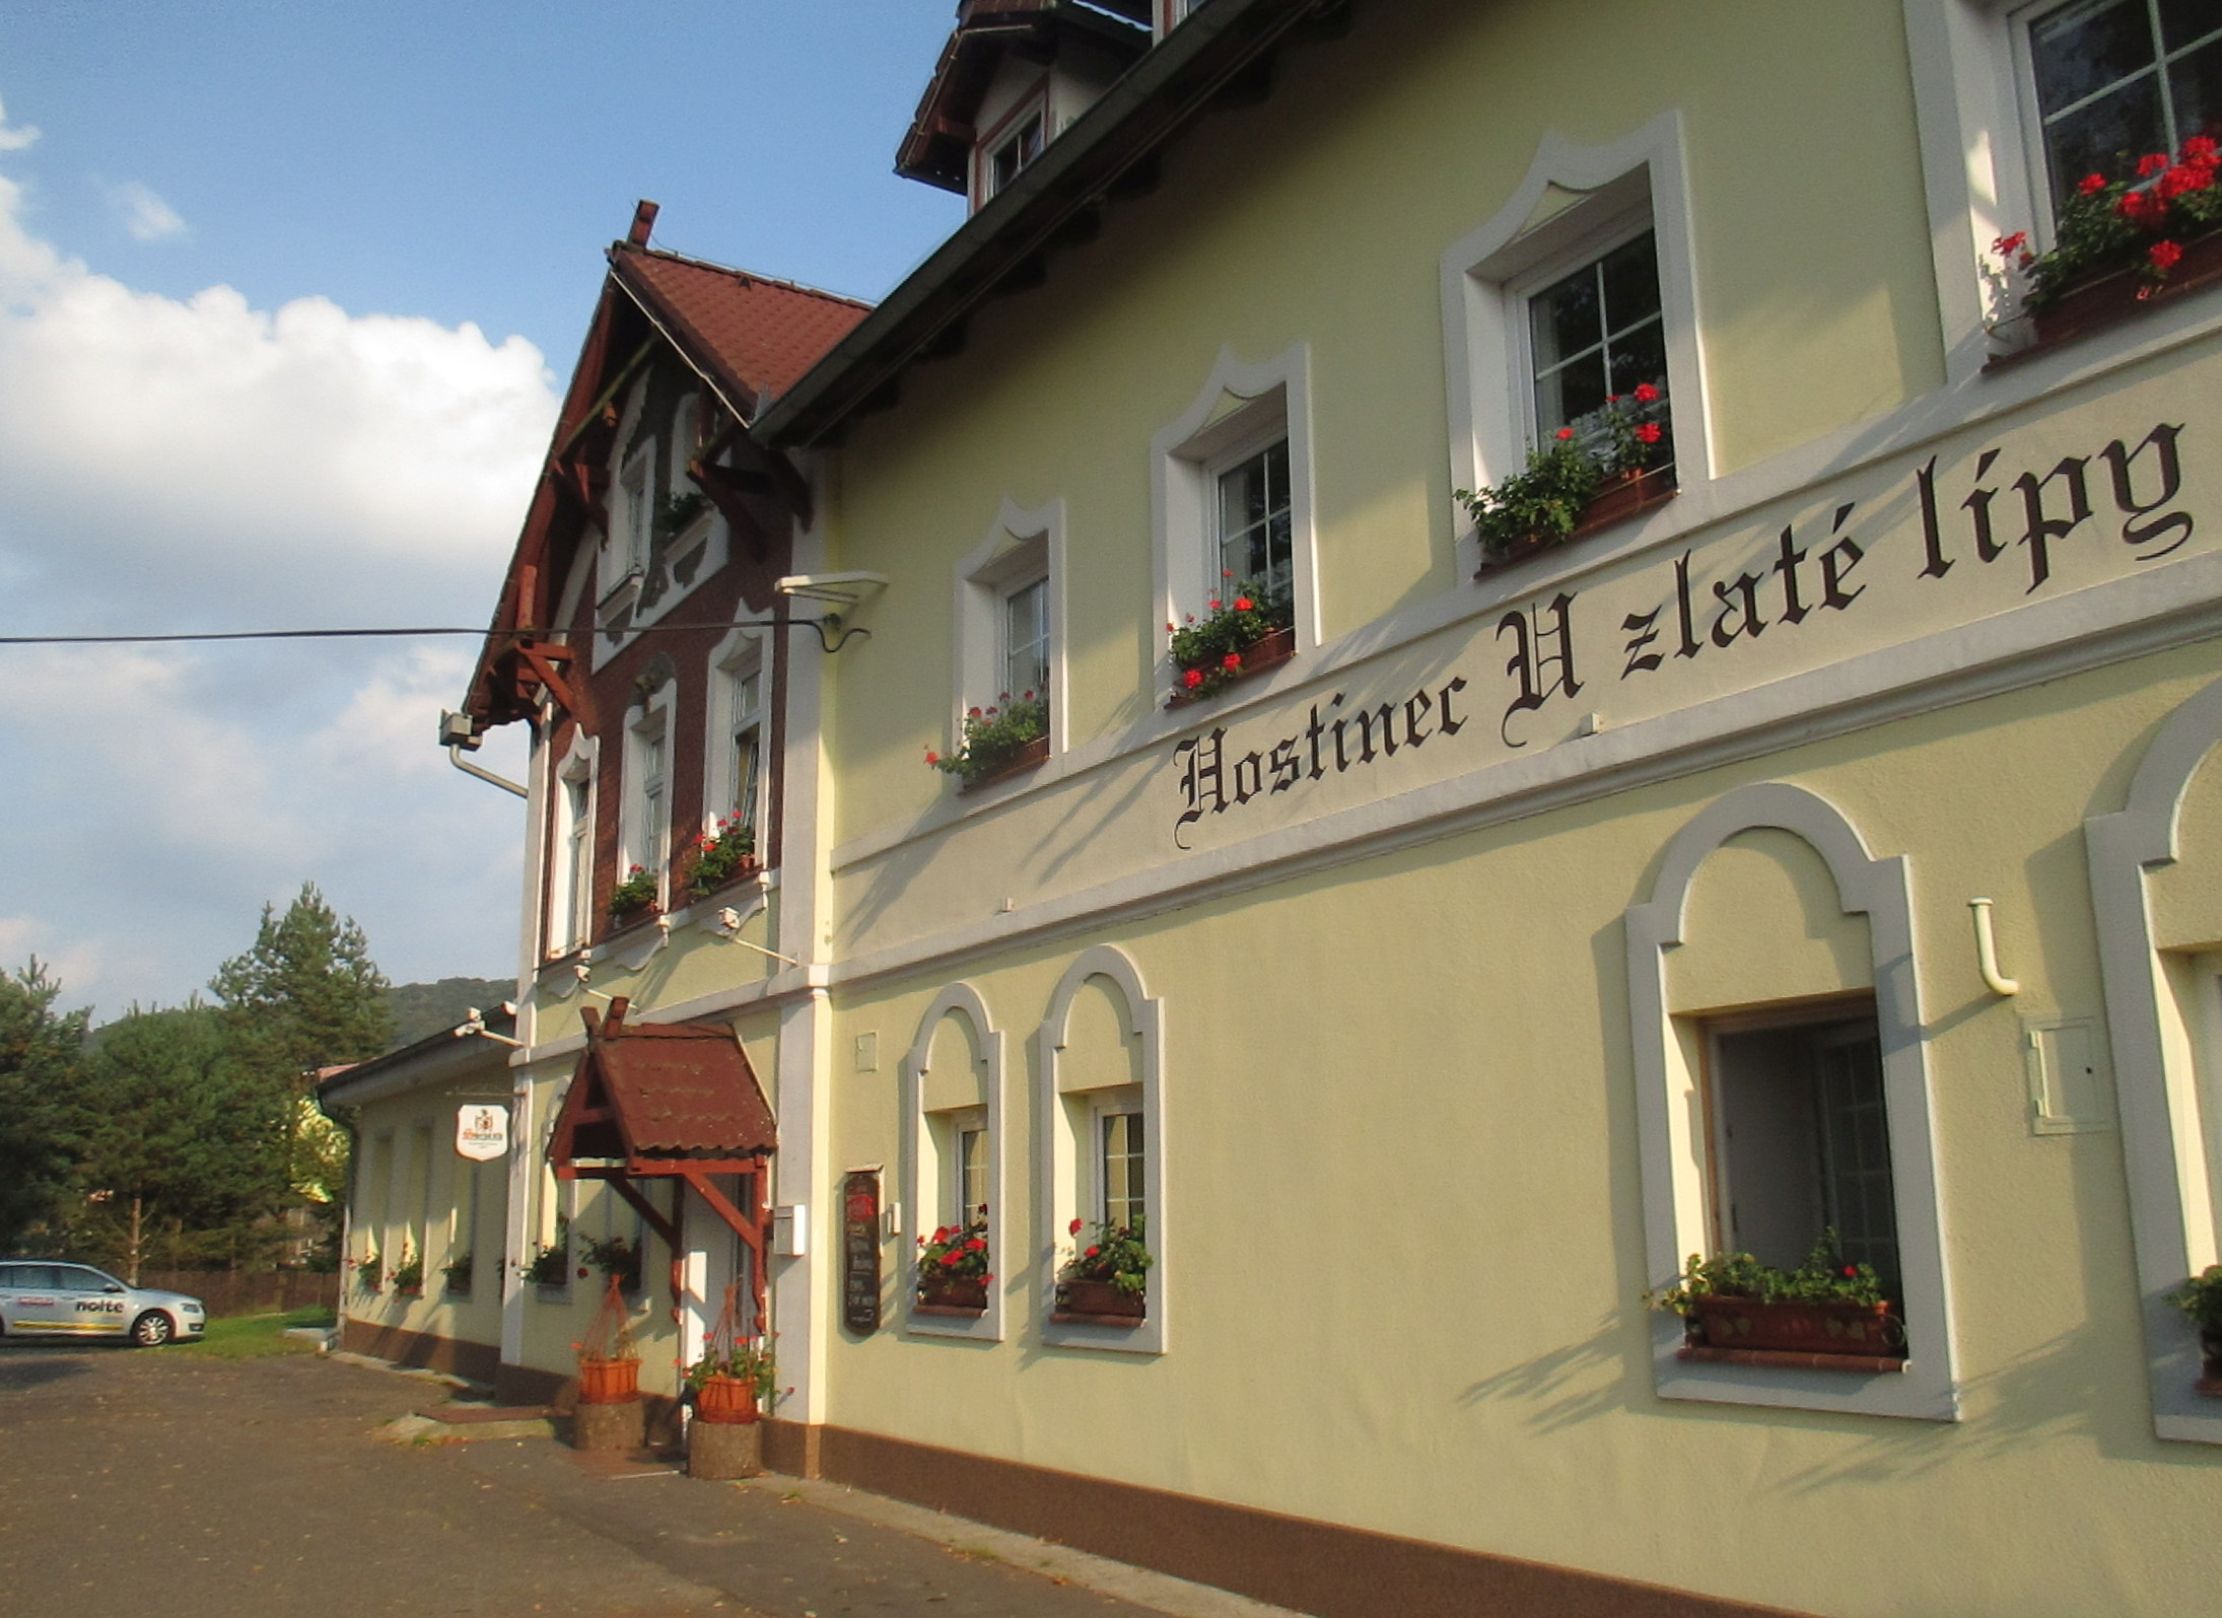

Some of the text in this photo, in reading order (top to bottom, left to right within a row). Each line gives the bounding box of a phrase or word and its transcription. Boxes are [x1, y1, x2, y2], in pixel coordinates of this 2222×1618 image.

[1173, 422, 2194, 850] Hostinec U zlaté lípy
